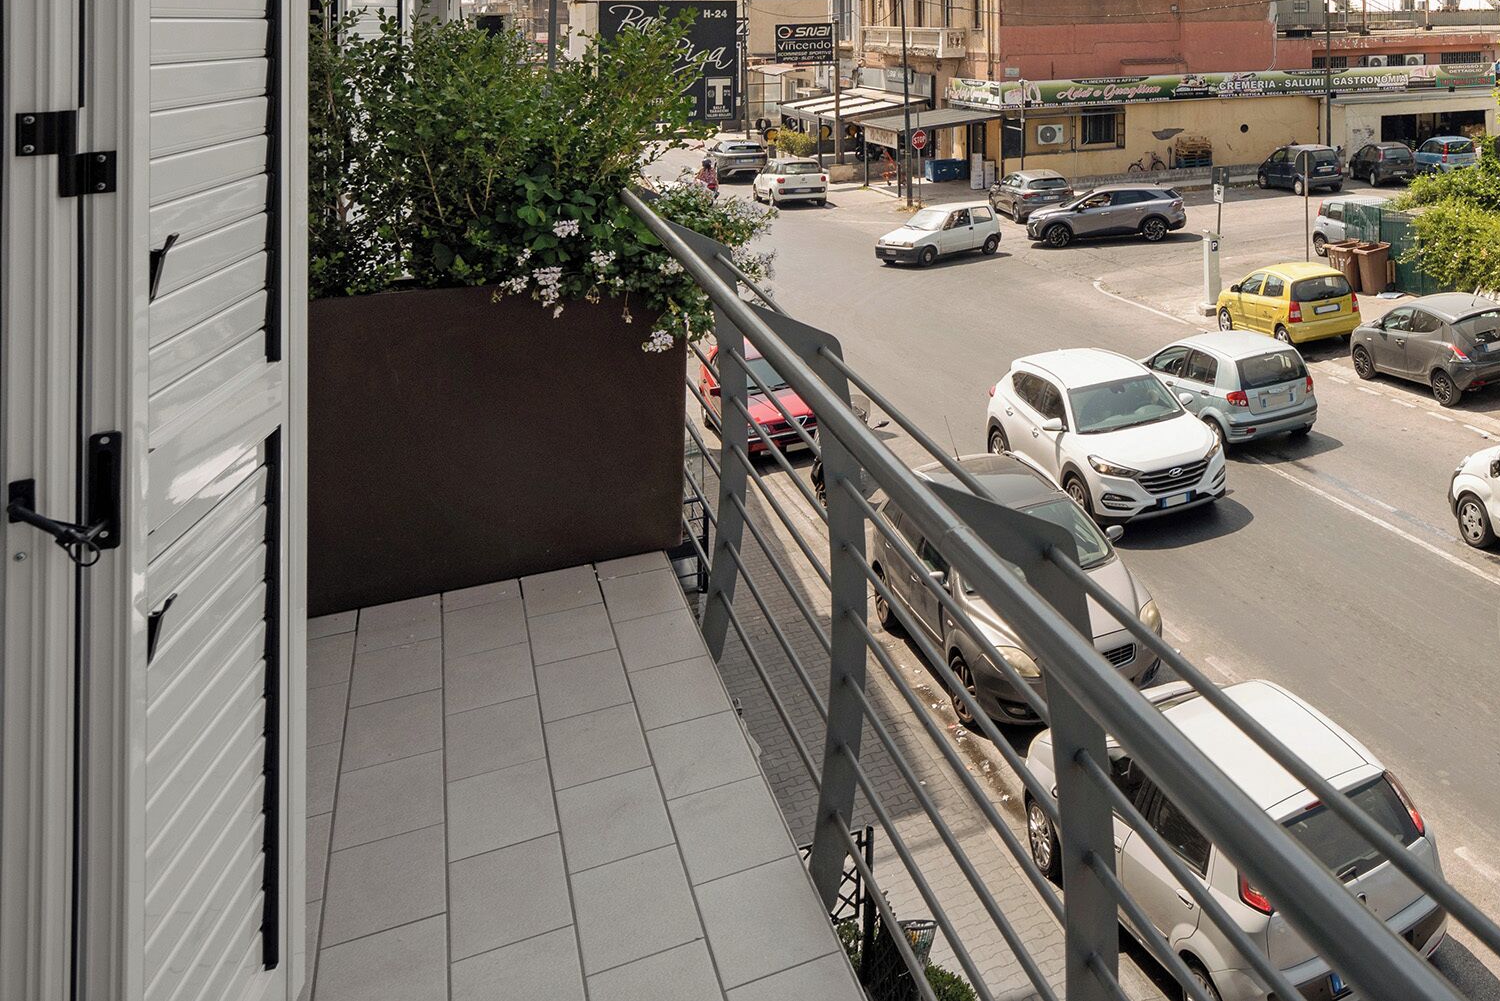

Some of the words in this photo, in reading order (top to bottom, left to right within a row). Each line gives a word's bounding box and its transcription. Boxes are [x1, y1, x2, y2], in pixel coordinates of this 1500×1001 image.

[704, 9, 728, 19] H-24
[778, 41, 831, 51] Vincendo
[1219, 80, 1276, 90] CREMERIA
[1284, 78, 1324, 87] SALUMI
[1333, 75, 1406, 85] GASTRONOMIA
[708, 79, 731, 106] T
[913, 135, 926, 144] STOP
[1212, 241, 1218, 250] P
